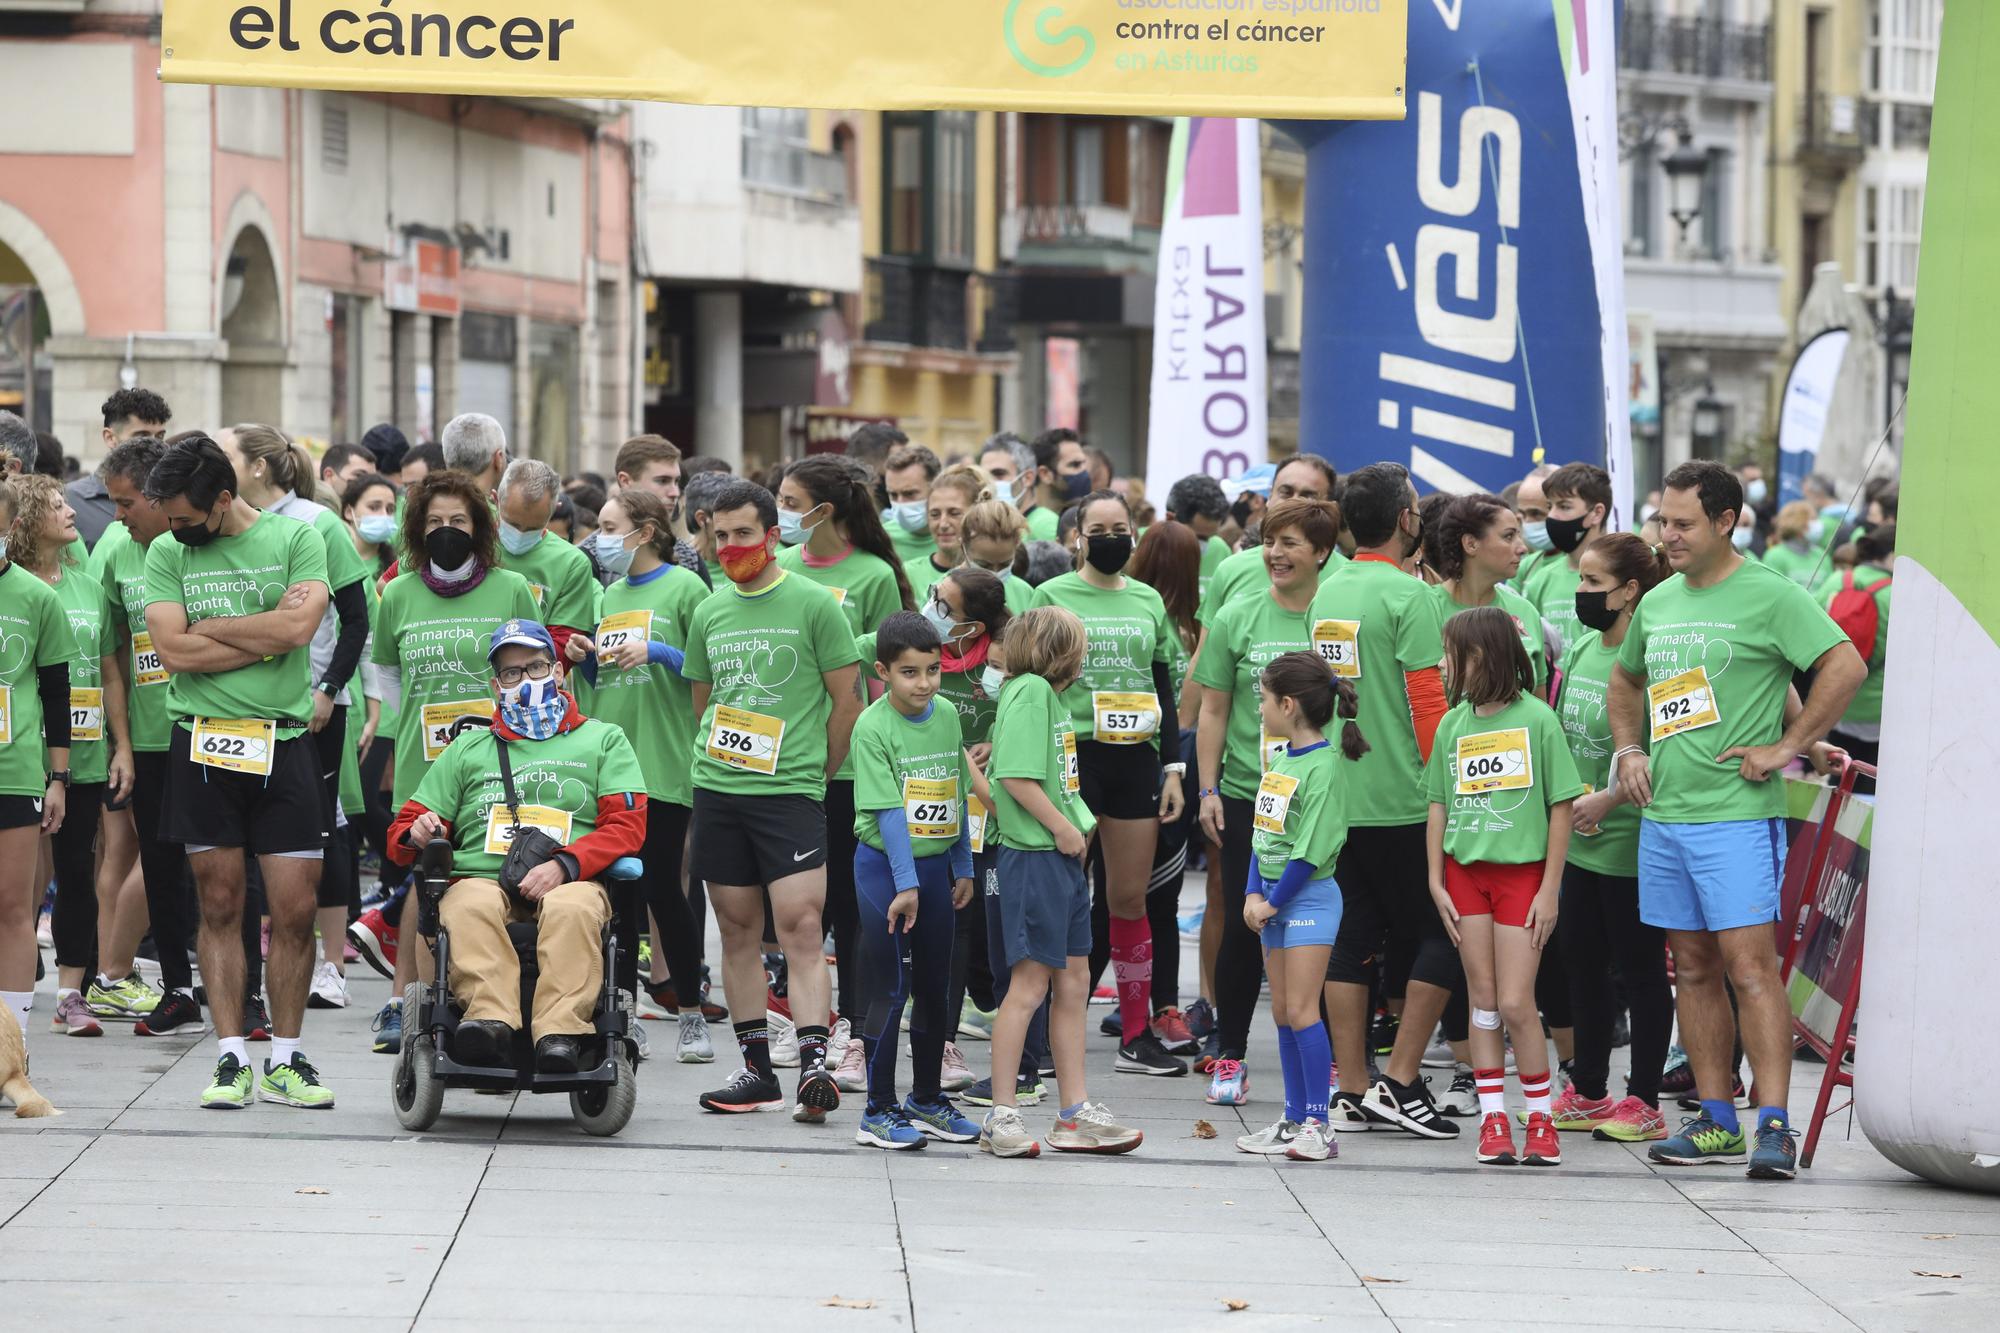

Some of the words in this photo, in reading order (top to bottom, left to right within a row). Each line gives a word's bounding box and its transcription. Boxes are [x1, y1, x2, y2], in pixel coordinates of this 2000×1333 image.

[229, 0, 300, 51] el
[319, 0, 575, 61] cáncer
[1116, 19, 1199, 40] contra
[1207, 19, 1228, 40] el
[1236, 20, 1325, 42] cáncer
[1115, 51, 1147, 70] en
[1153, 49, 1259, 73] Asturias
[209, 569, 232, 577] MARCHA
[184, 583, 200, 597] En
[204, 578, 257, 593] marcha
[1097, 624, 1142, 636] marcha
[1715, 622, 1736, 630] CÁNCER
[405, 632, 417, 645] En
[421, 626, 474, 641] marcha
[602, 632, 628, 649] 472
[1660, 631, 1705, 645] marcha
[721, 637, 769, 654] marcha
[1086, 641, 1118, 652] ontra
[1320, 644, 1341, 660] 333
[138, 653, 161, 671] 518
[1092, 655, 1132, 668] cáncer
[1250, 651, 1267, 662] En
[418, 660, 463, 675] cáncer
[720, 672, 757, 688] cáncer
[1571, 687, 1602, 704] marcha
[1564, 704, 1579, 716] ntra
[1661, 698, 1691, 720] 192
[1107, 714, 1139, 729] 537
[203, 737, 245, 756] 622
[718, 730, 752, 752] 396
[1467, 757, 1504, 777] 606
[483, 780, 499, 789] En
[476, 804, 489, 819] el
[914, 804, 947, 821] 672
[1259, 794, 1275, 814] 195
